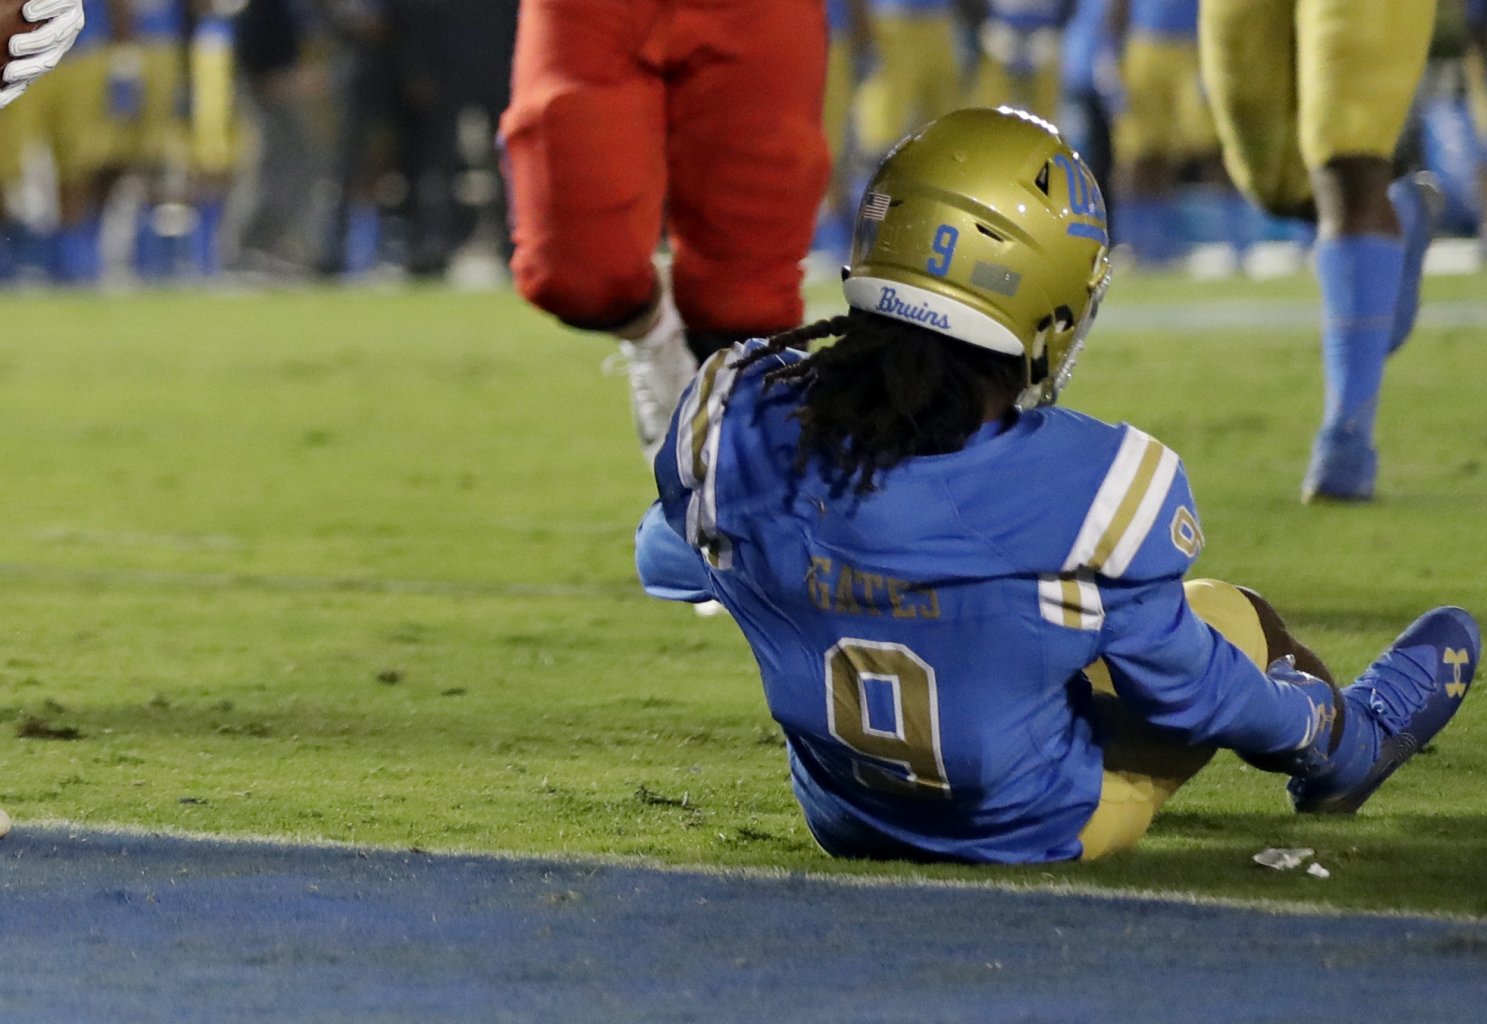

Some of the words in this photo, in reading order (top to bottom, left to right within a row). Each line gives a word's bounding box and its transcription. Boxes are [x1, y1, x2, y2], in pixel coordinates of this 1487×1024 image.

[927, 224, 959, 277] 9
[875, 286, 951, 330] Bruins
[825, 637, 952, 799] 9
